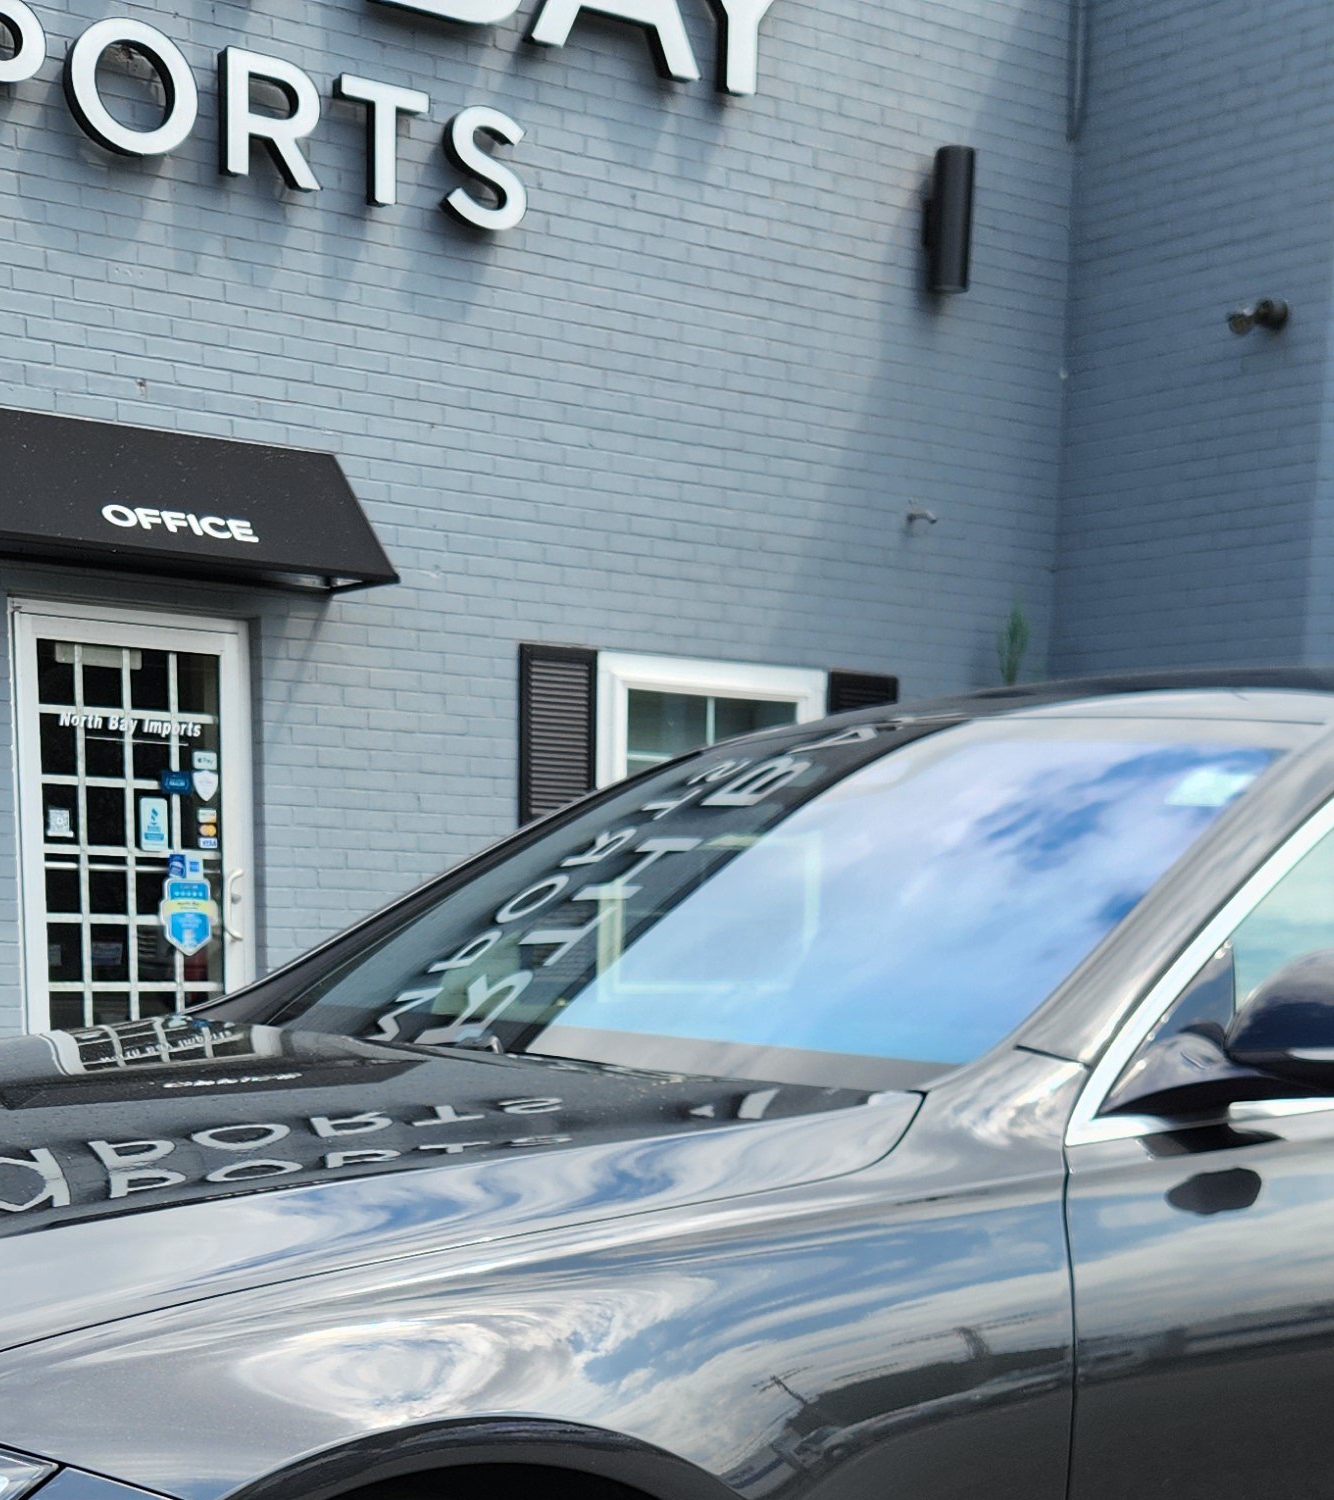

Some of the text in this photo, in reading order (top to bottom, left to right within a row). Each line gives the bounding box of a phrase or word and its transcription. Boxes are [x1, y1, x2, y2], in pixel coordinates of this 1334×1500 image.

[101, 504, 260, 544] OFFICE
[58, 712, 202, 738] North Bay Imports
